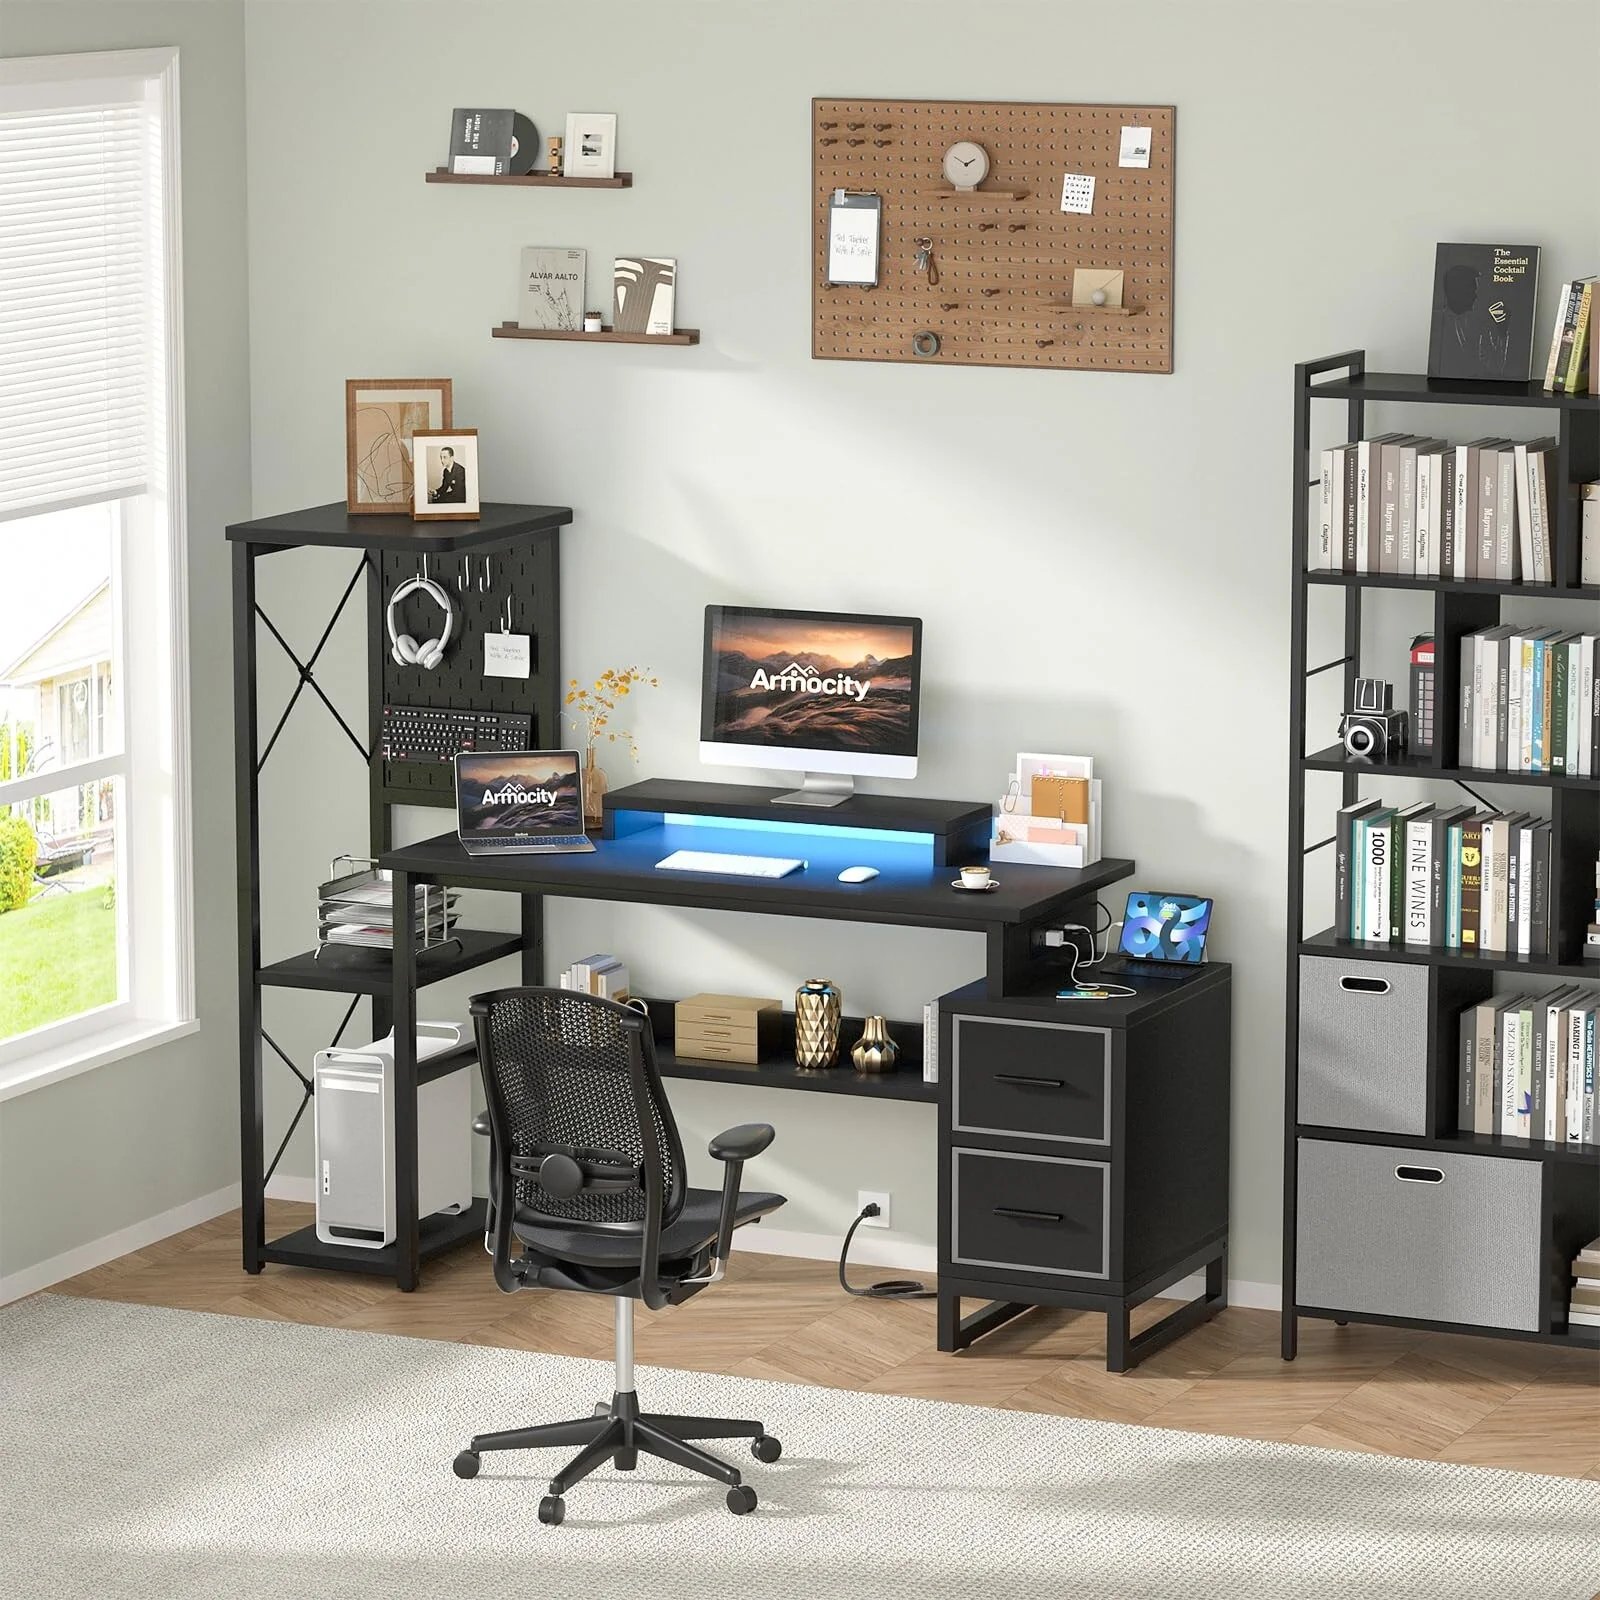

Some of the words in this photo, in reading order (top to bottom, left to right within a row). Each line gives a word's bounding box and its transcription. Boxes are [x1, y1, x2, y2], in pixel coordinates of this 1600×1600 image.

[1384, 503, 1394, 531] Мартин
[1482, 508, 1493, 536] Мартин
[1385, 535, 1394, 554] Иден
[1482, 540, 1492, 559] Иден
[750, 665, 871, 702] Armocity
[482, 784, 558, 807] Armocity
[1372, 832, 1385, 865] 1000
[1412, 839, 1426, 872] FINE
[1411, 880, 1425, 928] WINES
[1572, 1051, 1579, 1060] IT
[1505, 1066, 1514, 1118] JOHANNES
